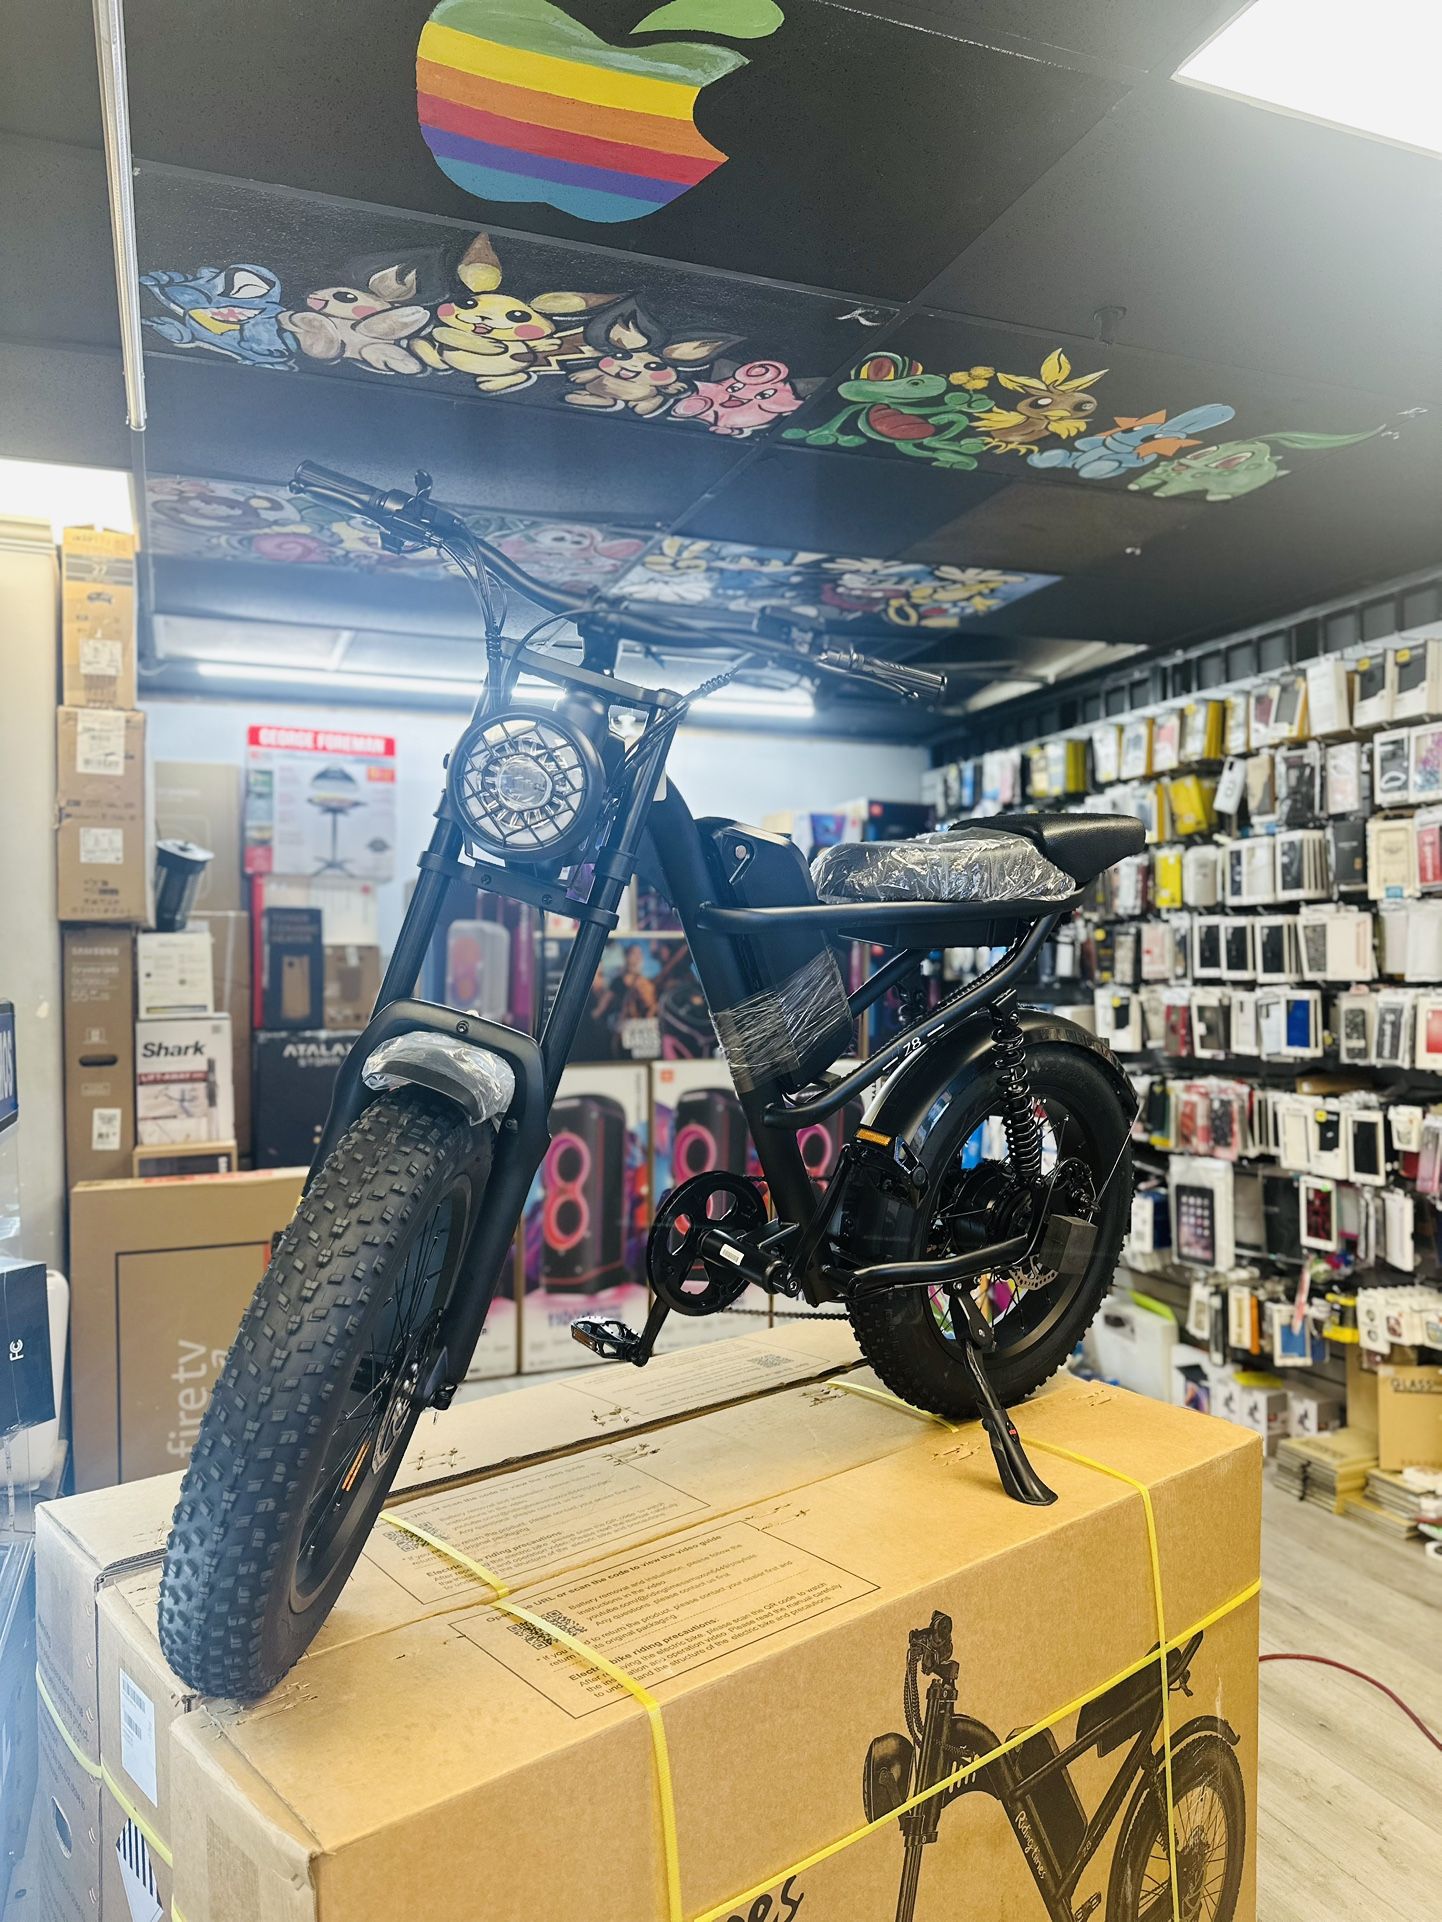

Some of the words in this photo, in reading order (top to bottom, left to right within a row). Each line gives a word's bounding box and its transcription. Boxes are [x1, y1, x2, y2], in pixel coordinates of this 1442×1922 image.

[258, 727, 314, 749] GEORGE
[317, 732, 387, 755] FOREMAN
[142, 1040, 205, 1059] Shark
[903, 1036, 922, 1057] Z8
[532, 1595, 555, 1605] URL
[568, 1583, 590, 1592] scan
[606, 1569, 629, 1578] code
[640, 1558, 661, 1566] view
[675, 1544, 699, 1554] video
[699, 1536, 722, 1546] guide
[567, 1597, 600, 1609] Battery
[598, 1585, 630, 1598] removal
[550, 1649, 568, 1658] you
[601, 1626, 626, 1637] return
[673, 1597, 699, 1610] please
[699, 1586, 726, 1599] contact
[577, 1675, 601, 1686] After
[655, 1640, 686, 1654] electric
[706, 1621, 733, 1634] please
[732, 1614, 752, 1623] scan
[762, 1602, 778, 1610] QR
[777, 1595, 797, 1604] code
[549, 1654, 576, 1666] return
[605, 1630, 636, 1644] original
[567, 1665, 603, 1680] Electr
[608, 1653, 632, 1664] bike
[632, 1641, 664, 1654] riding
[585, 1684, 602, 1692] the
[666, 1641, 705, 1658] operation
[728, 1620, 756, 1632] Please
[755, 1612, 774, 1621] read
[669, 1649, 706, 1666] structure
[730, 1626, 760, 1640] electric
